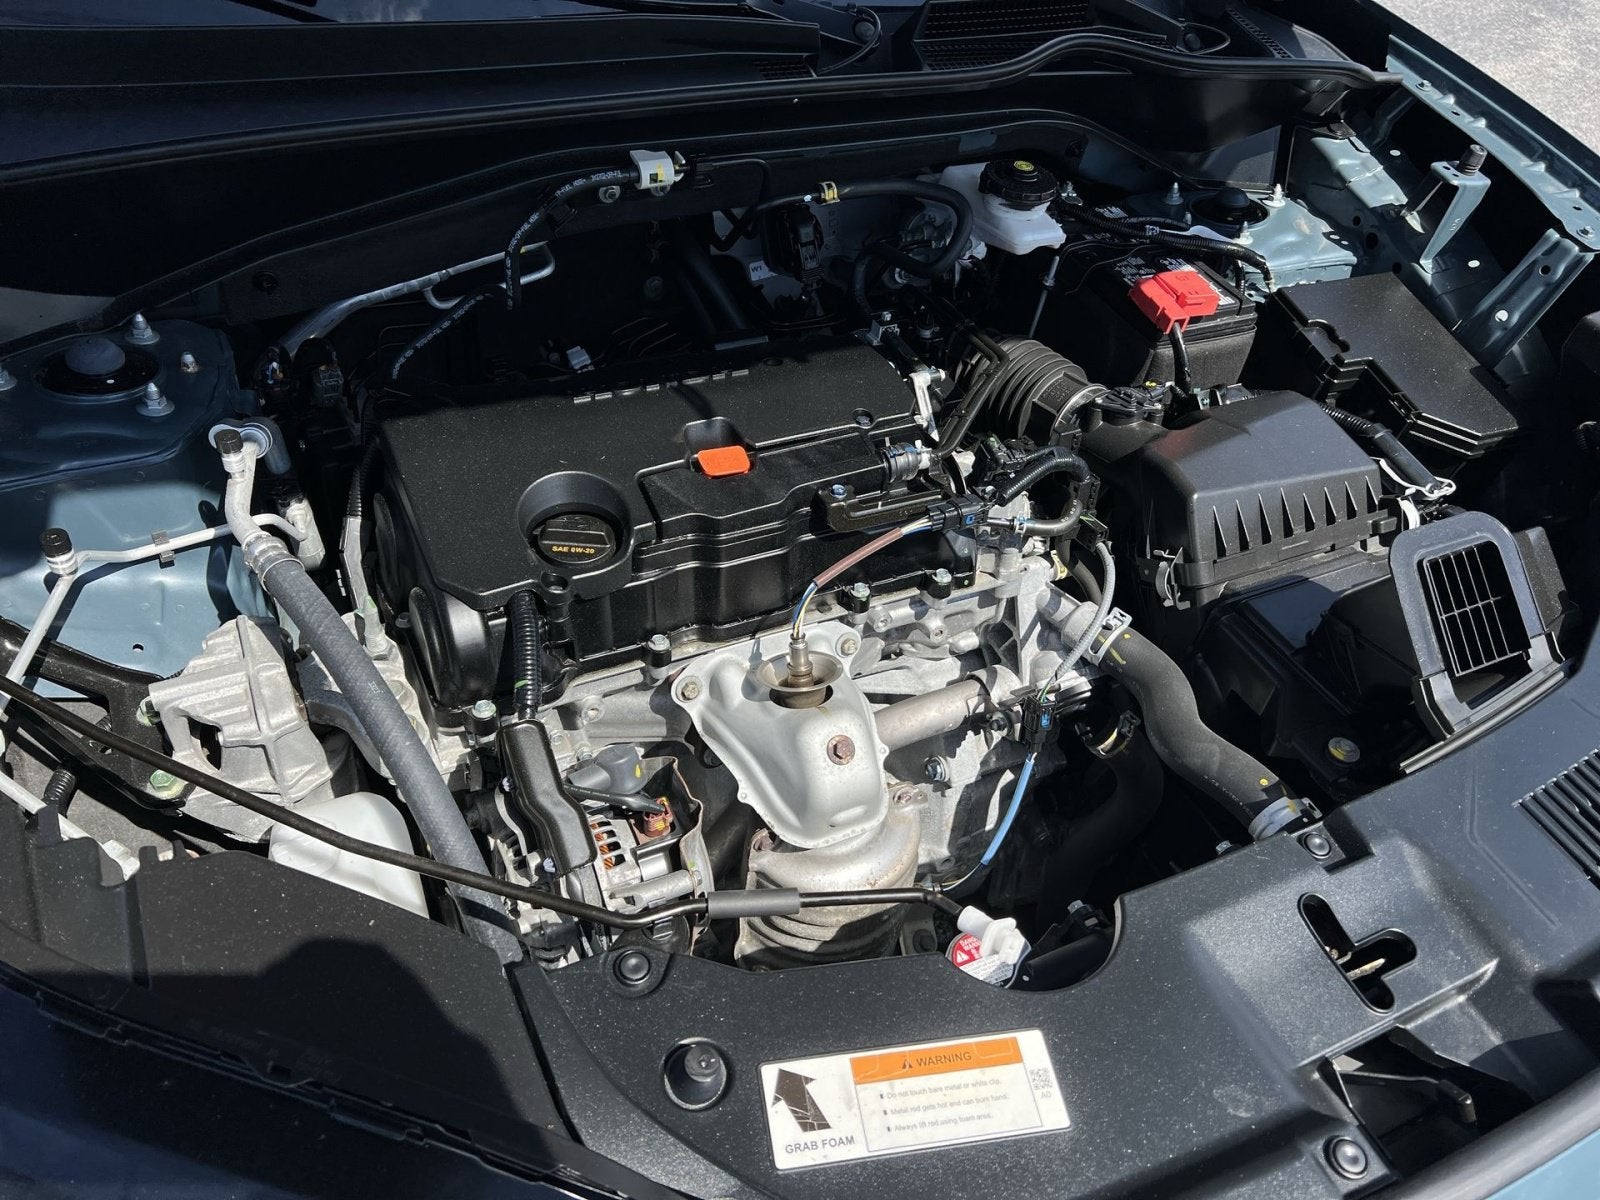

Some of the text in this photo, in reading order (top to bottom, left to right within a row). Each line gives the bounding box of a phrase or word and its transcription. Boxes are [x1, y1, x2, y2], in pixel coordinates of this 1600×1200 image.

[571, 546, 595, 554] 0W-20
[916, 1051, 972, 1067] WARNING
[886, 1091, 897, 1099] Do
[898, 1090, 909, 1098] not
[909, 1088, 928, 1096] touch
[928, 1086, 943, 1094] bare
[944, 1082, 962, 1092] metal
[971, 1080, 988, 1089] white
[890, 1105, 909, 1115] Metal
[910, 1104, 921, 1113] rod
[922, 1103, 936, 1112] gets
[937, 1100, 948, 1109] hot
[949, 1099, 962, 1108] and
[963, 1098, 974, 1106] can
[894, 1120, 918, 1131] Always
[919, 1120, 927, 1128] lift
[928, 1119, 939, 1127] rod
[940, 1116, 958, 1127] using
[959, 1114, 975, 1122] foam
[784, 1135, 855, 1154] GRAB FOAM
